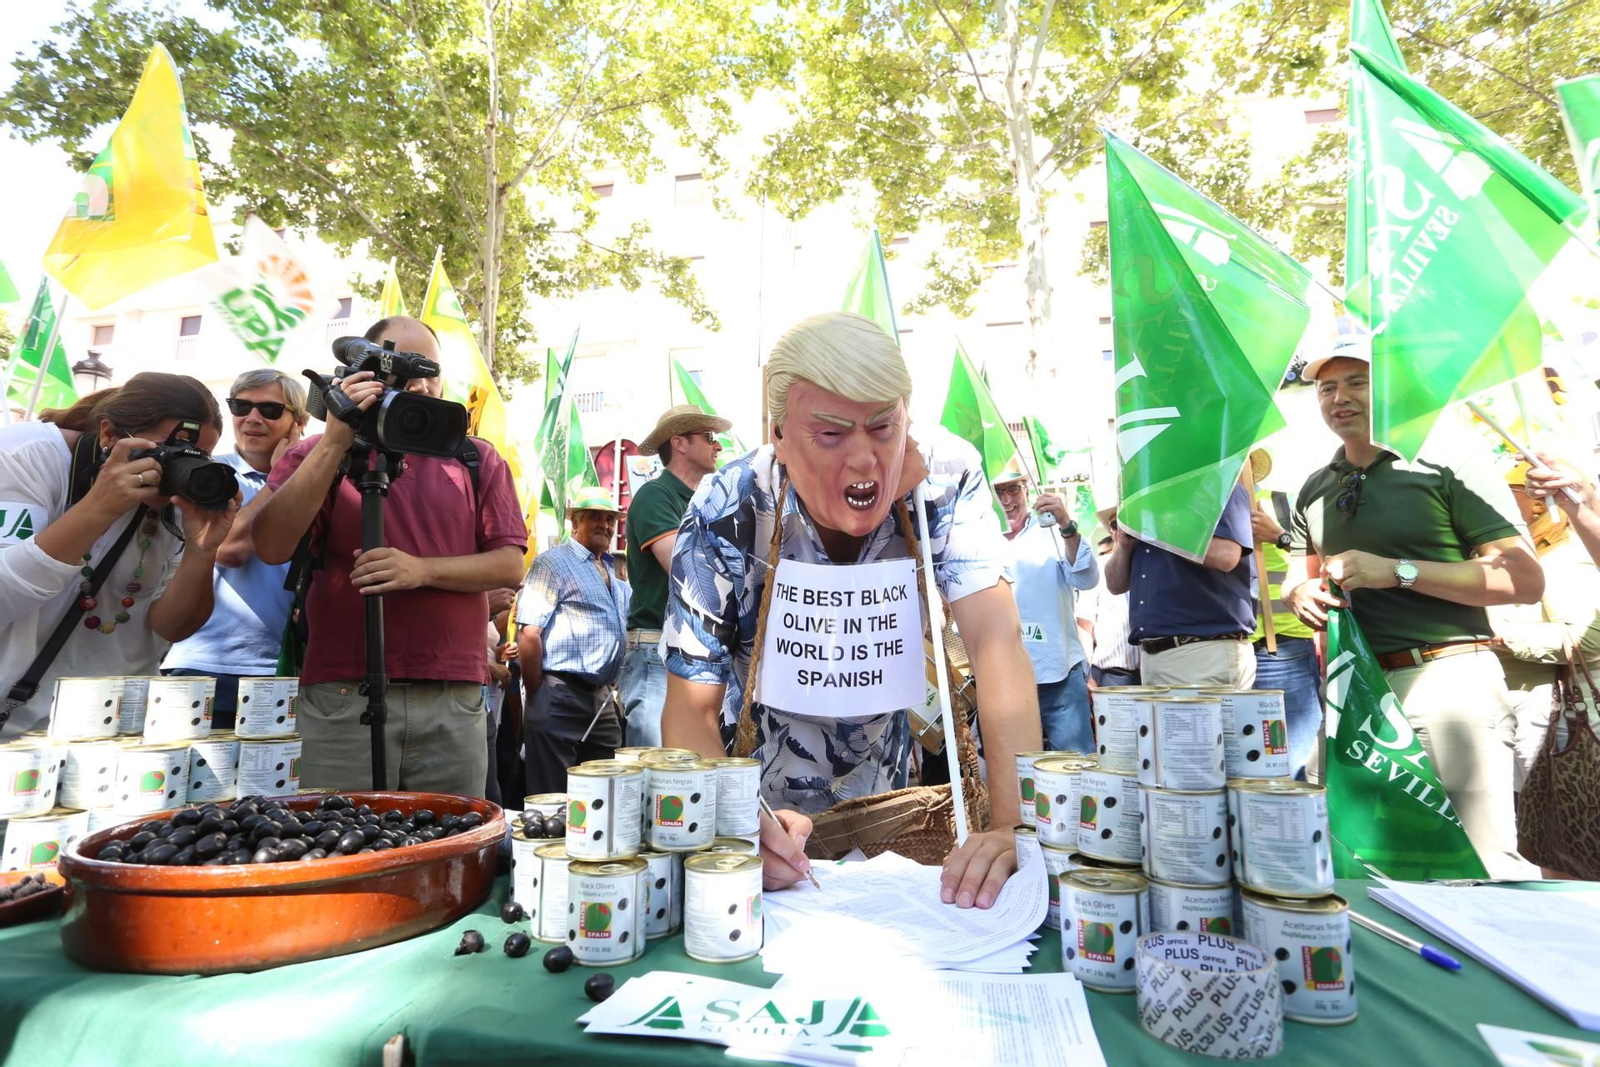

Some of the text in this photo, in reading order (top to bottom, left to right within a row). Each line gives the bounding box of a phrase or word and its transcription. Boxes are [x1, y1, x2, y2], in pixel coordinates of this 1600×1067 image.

[184, 448, 201, 456] Nikon
[776, 583, 908, 607] THE BEST BLACK
[783, 613, 897, 634] OLIVE IN THE
[776, 637, 903, 661] WORLD IS THE
[797, 669, 883, 688] SPANISH
[596, 882, 615, 890] Olives
[1094, 900, 1115, 909] Olives
[1185, 896, 1219, 904] Aceitunas
[1283, 921, 1325, 930] Aceitunas
[1197, 934, 1236, 951] PLUS
[1088, 953, 1113, 961] SPAIN
[1164, 948, 1199, 960] PLUS
[1202, 955, 1227, 965] OFFICE
[1172, 987, 1204, 1022] PLUS
[1145, 1000, 1167, 1031] PLUS
